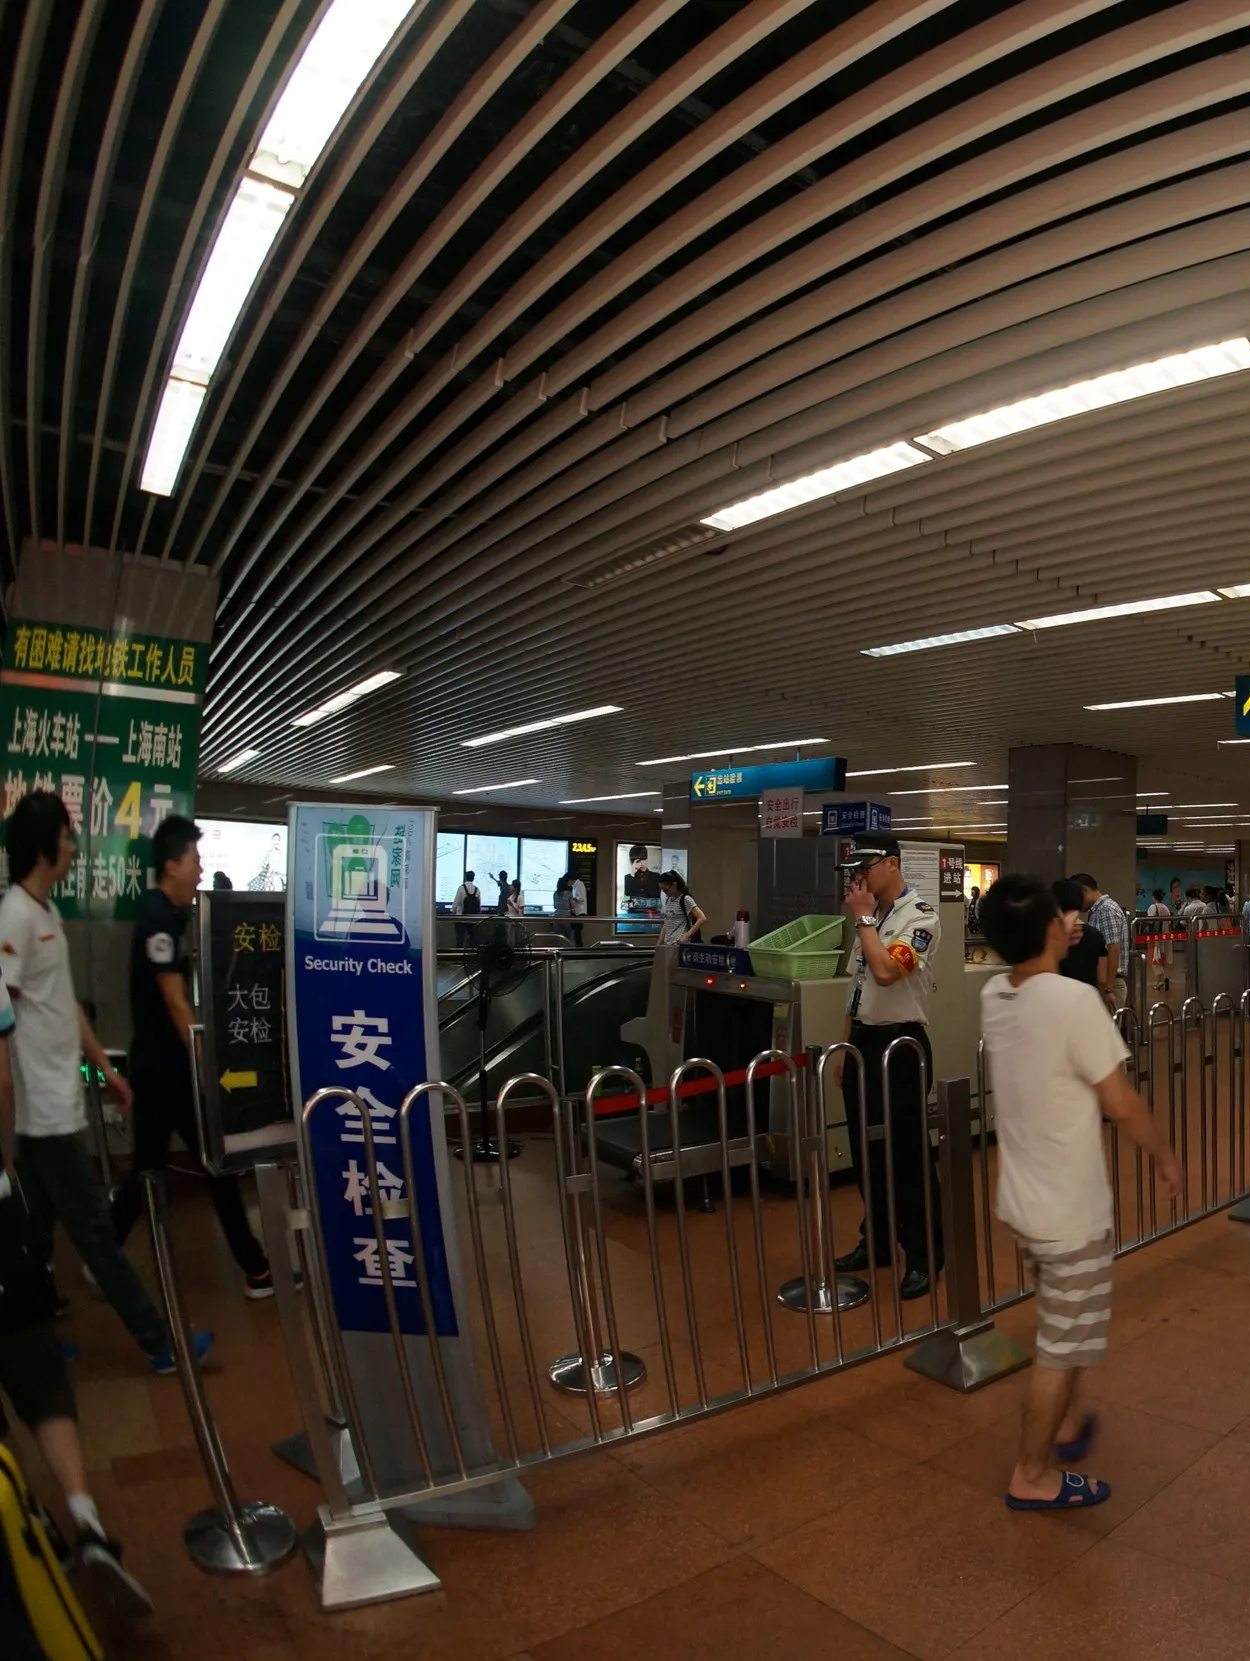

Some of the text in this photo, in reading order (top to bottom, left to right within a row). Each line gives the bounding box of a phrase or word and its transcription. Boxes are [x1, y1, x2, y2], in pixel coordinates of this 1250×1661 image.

[14, 625, 195, 686] 有困难请找地铁工作人员
[2, 768, 174, 840] 地票价4元
[766, 798, 800, 812] 安全出行
[941, 857, 963, 870] 1号线
[943, 872, 962, 884] 进站
[234, 922, 282, 953] 安检
[304, 955, 413, 976] Security Check
[227, 983, 271, 1011] 大包
[228, 1016, 272, 1045] 安检
[330, 1009, 419, 1289] 安全检查
